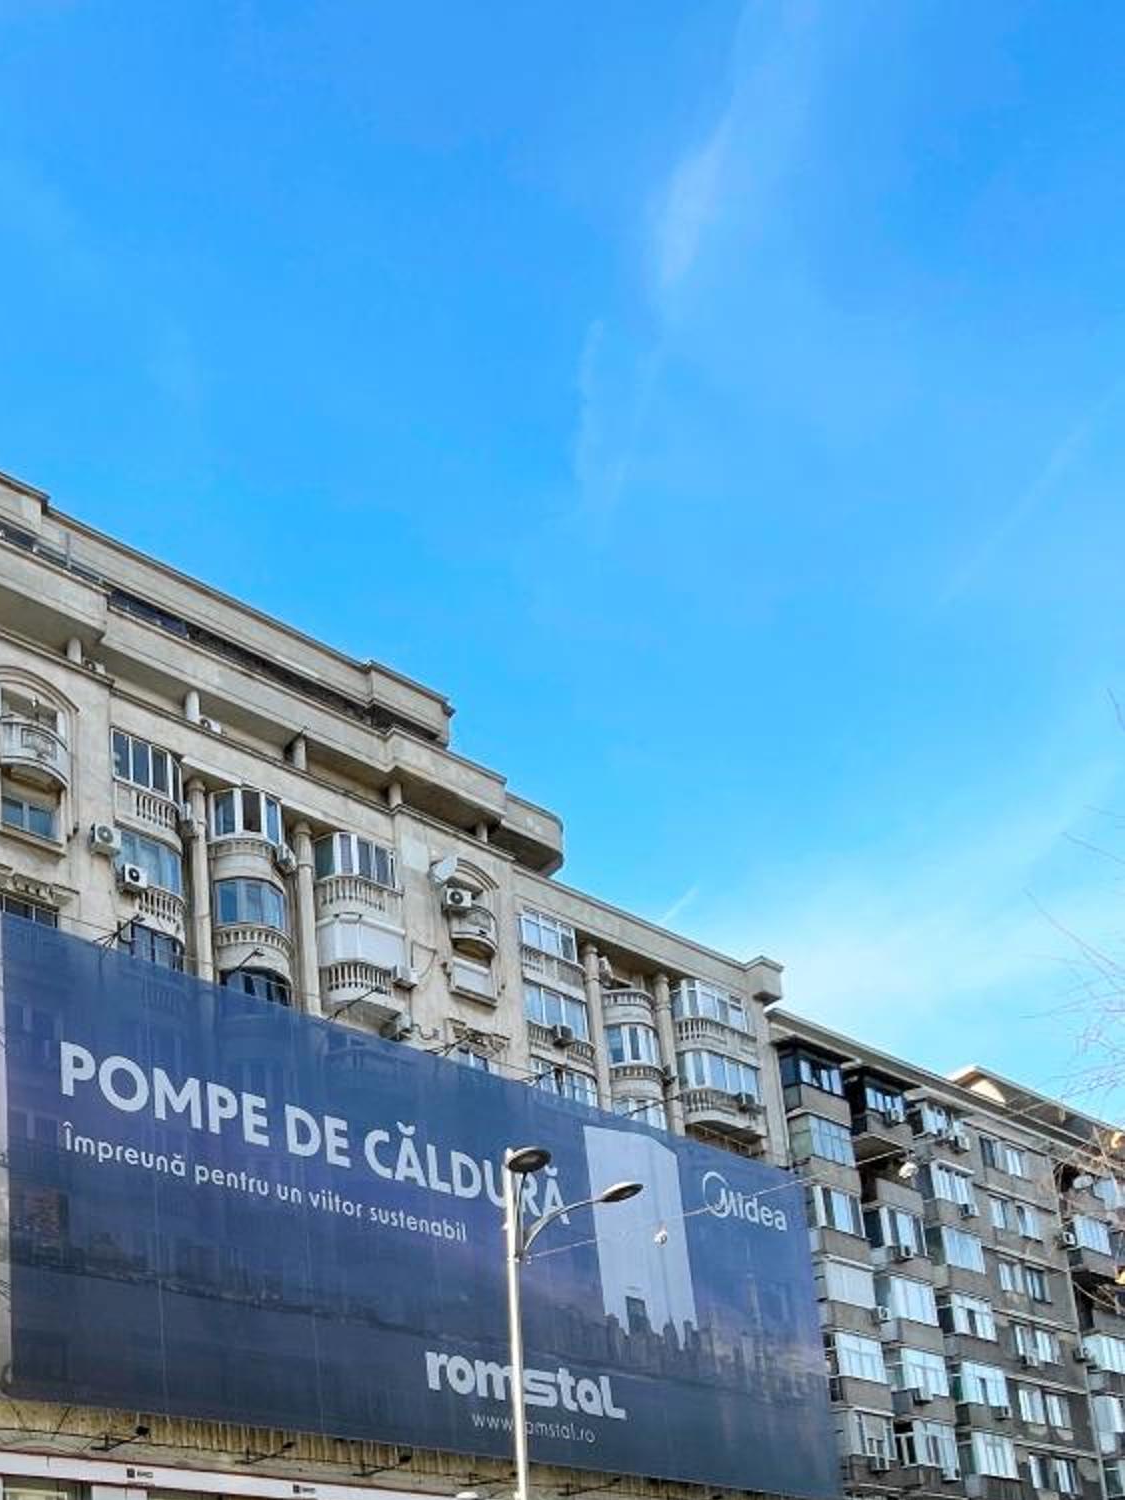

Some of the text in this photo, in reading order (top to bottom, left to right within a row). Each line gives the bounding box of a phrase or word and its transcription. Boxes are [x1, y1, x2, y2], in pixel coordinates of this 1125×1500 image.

[60, 1040, 571, 1226] POMPE DE CĂLDURĂ
[62, 1121, 468, 1243] Împreună pentru un viitor sustenabil
[702, 1170, 788, 1231] Midea
[425, 1351, 627, 1420] romstal
[471, 1412, 596, 1443] wwwomstal.ro
